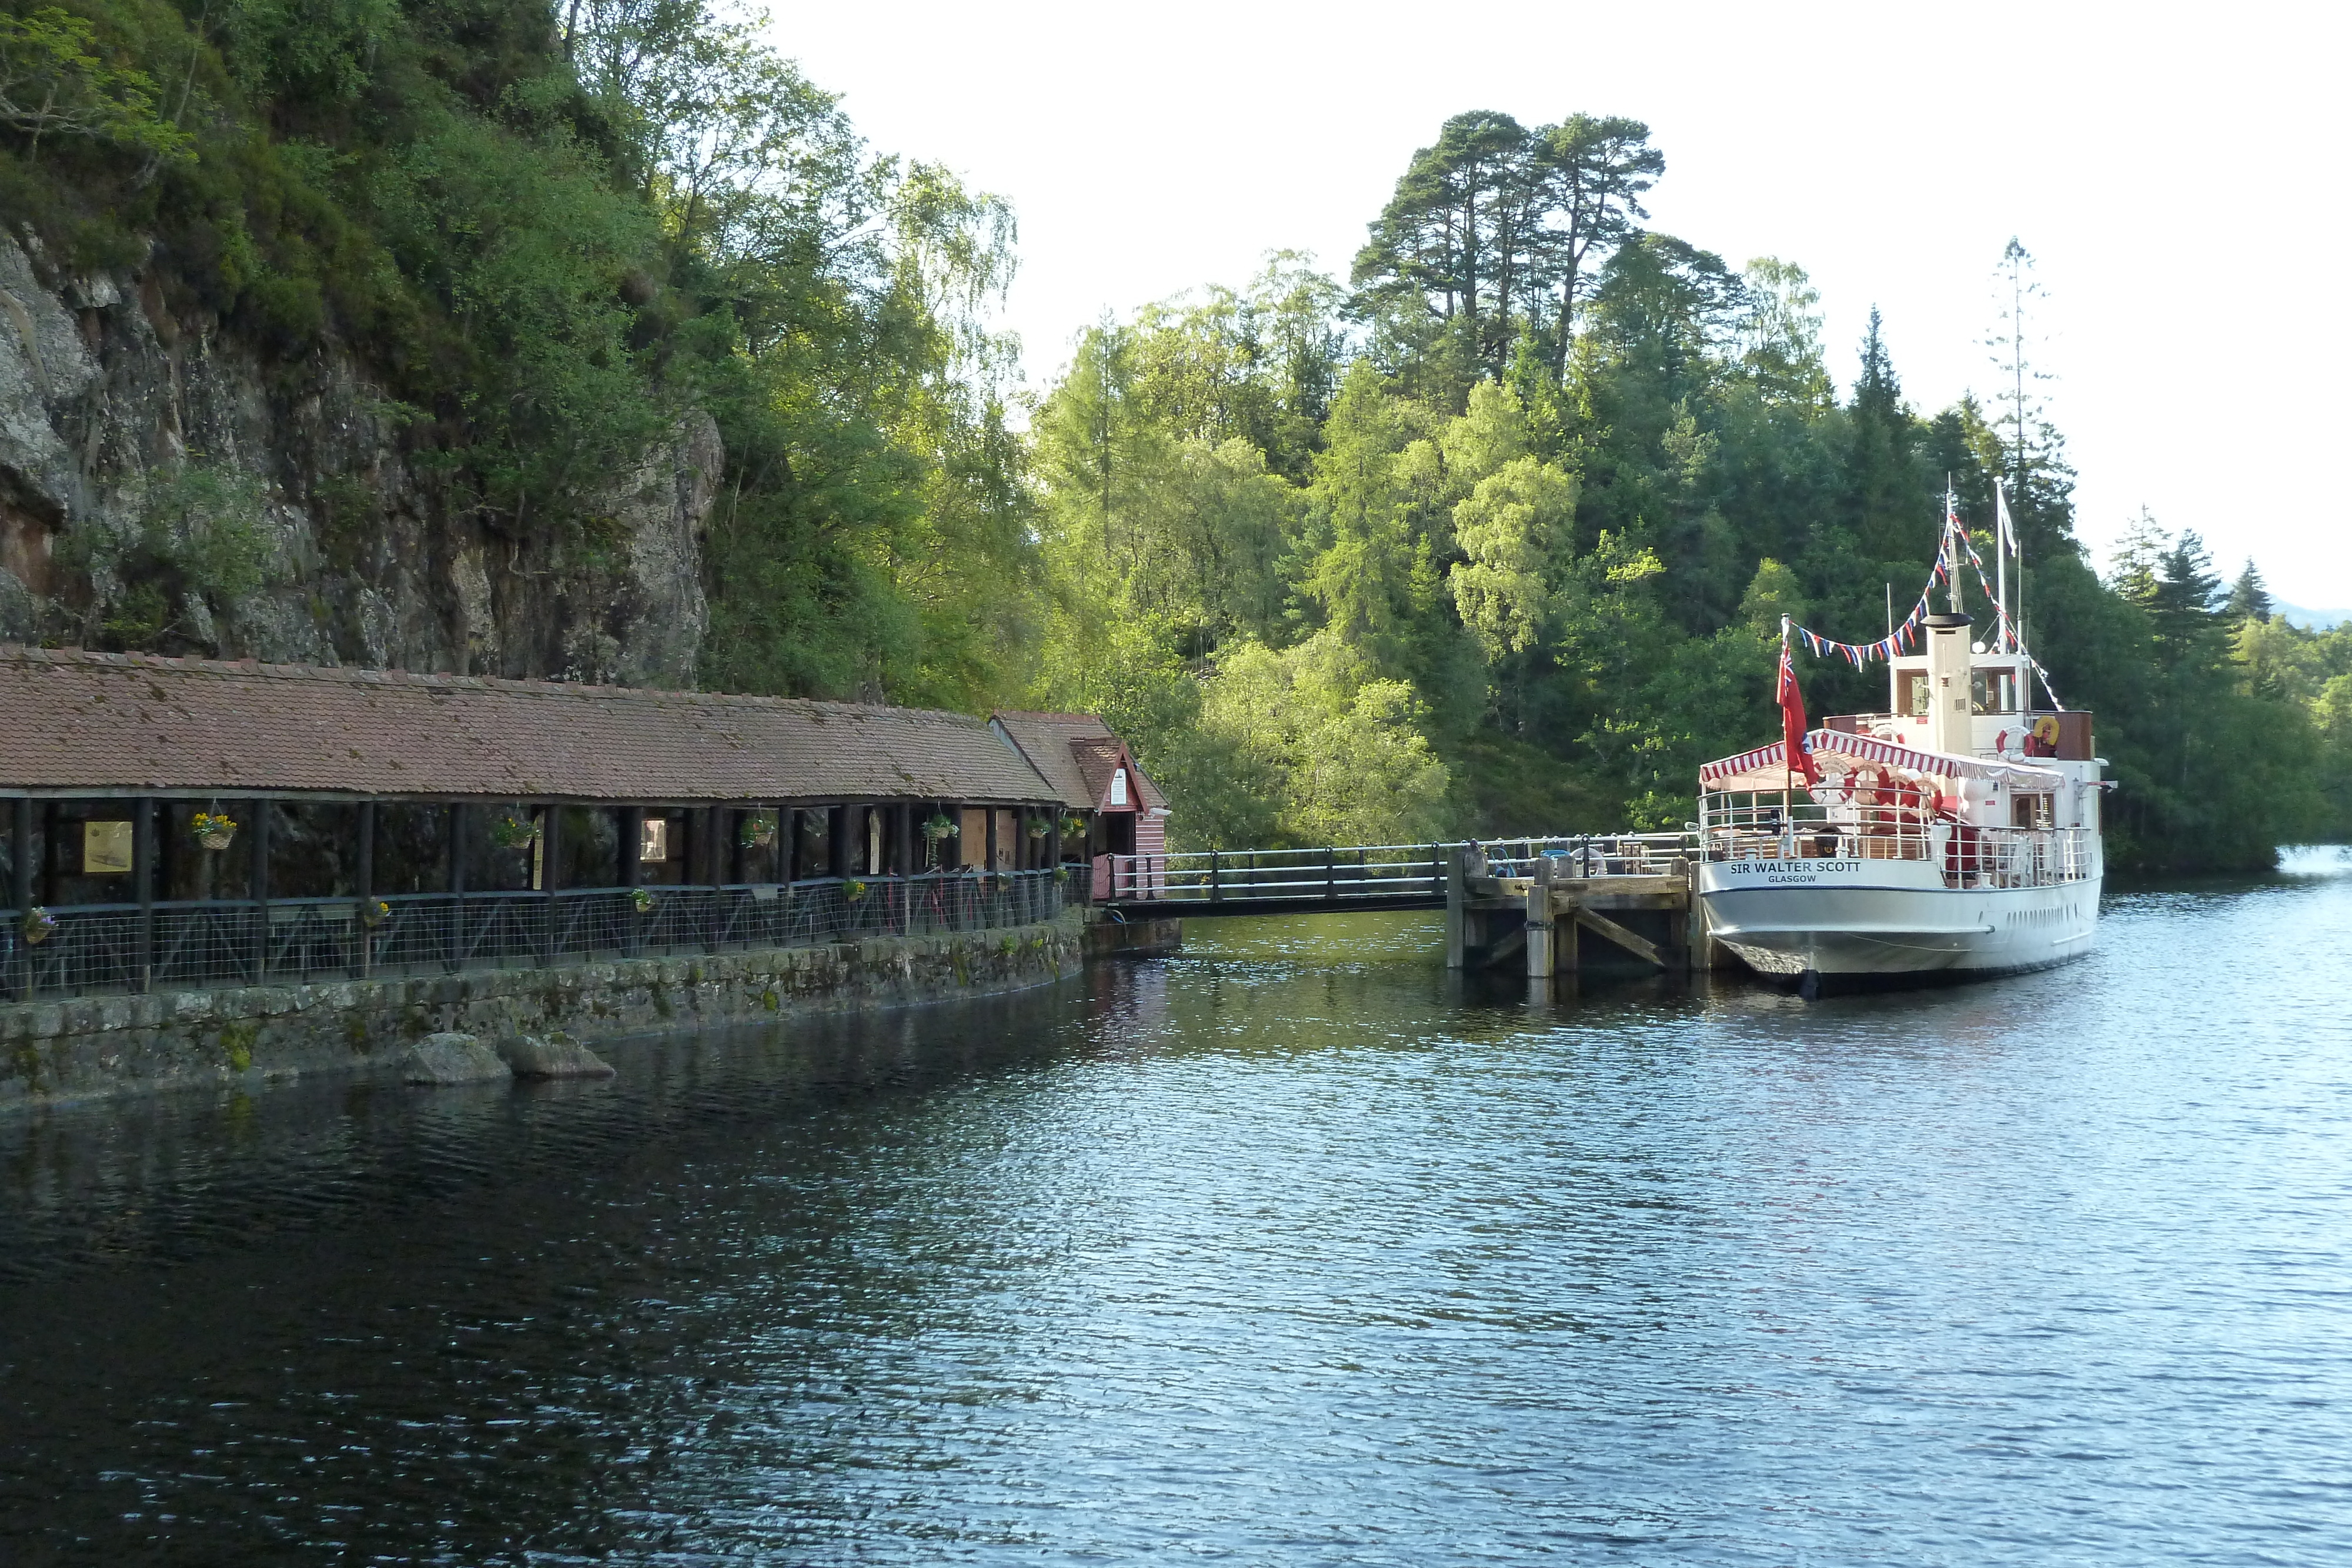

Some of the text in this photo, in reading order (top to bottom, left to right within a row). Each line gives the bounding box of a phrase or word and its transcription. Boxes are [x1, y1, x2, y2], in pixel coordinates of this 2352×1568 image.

[1731, 862, 1860, 874] SIR WALTER SCOTT
